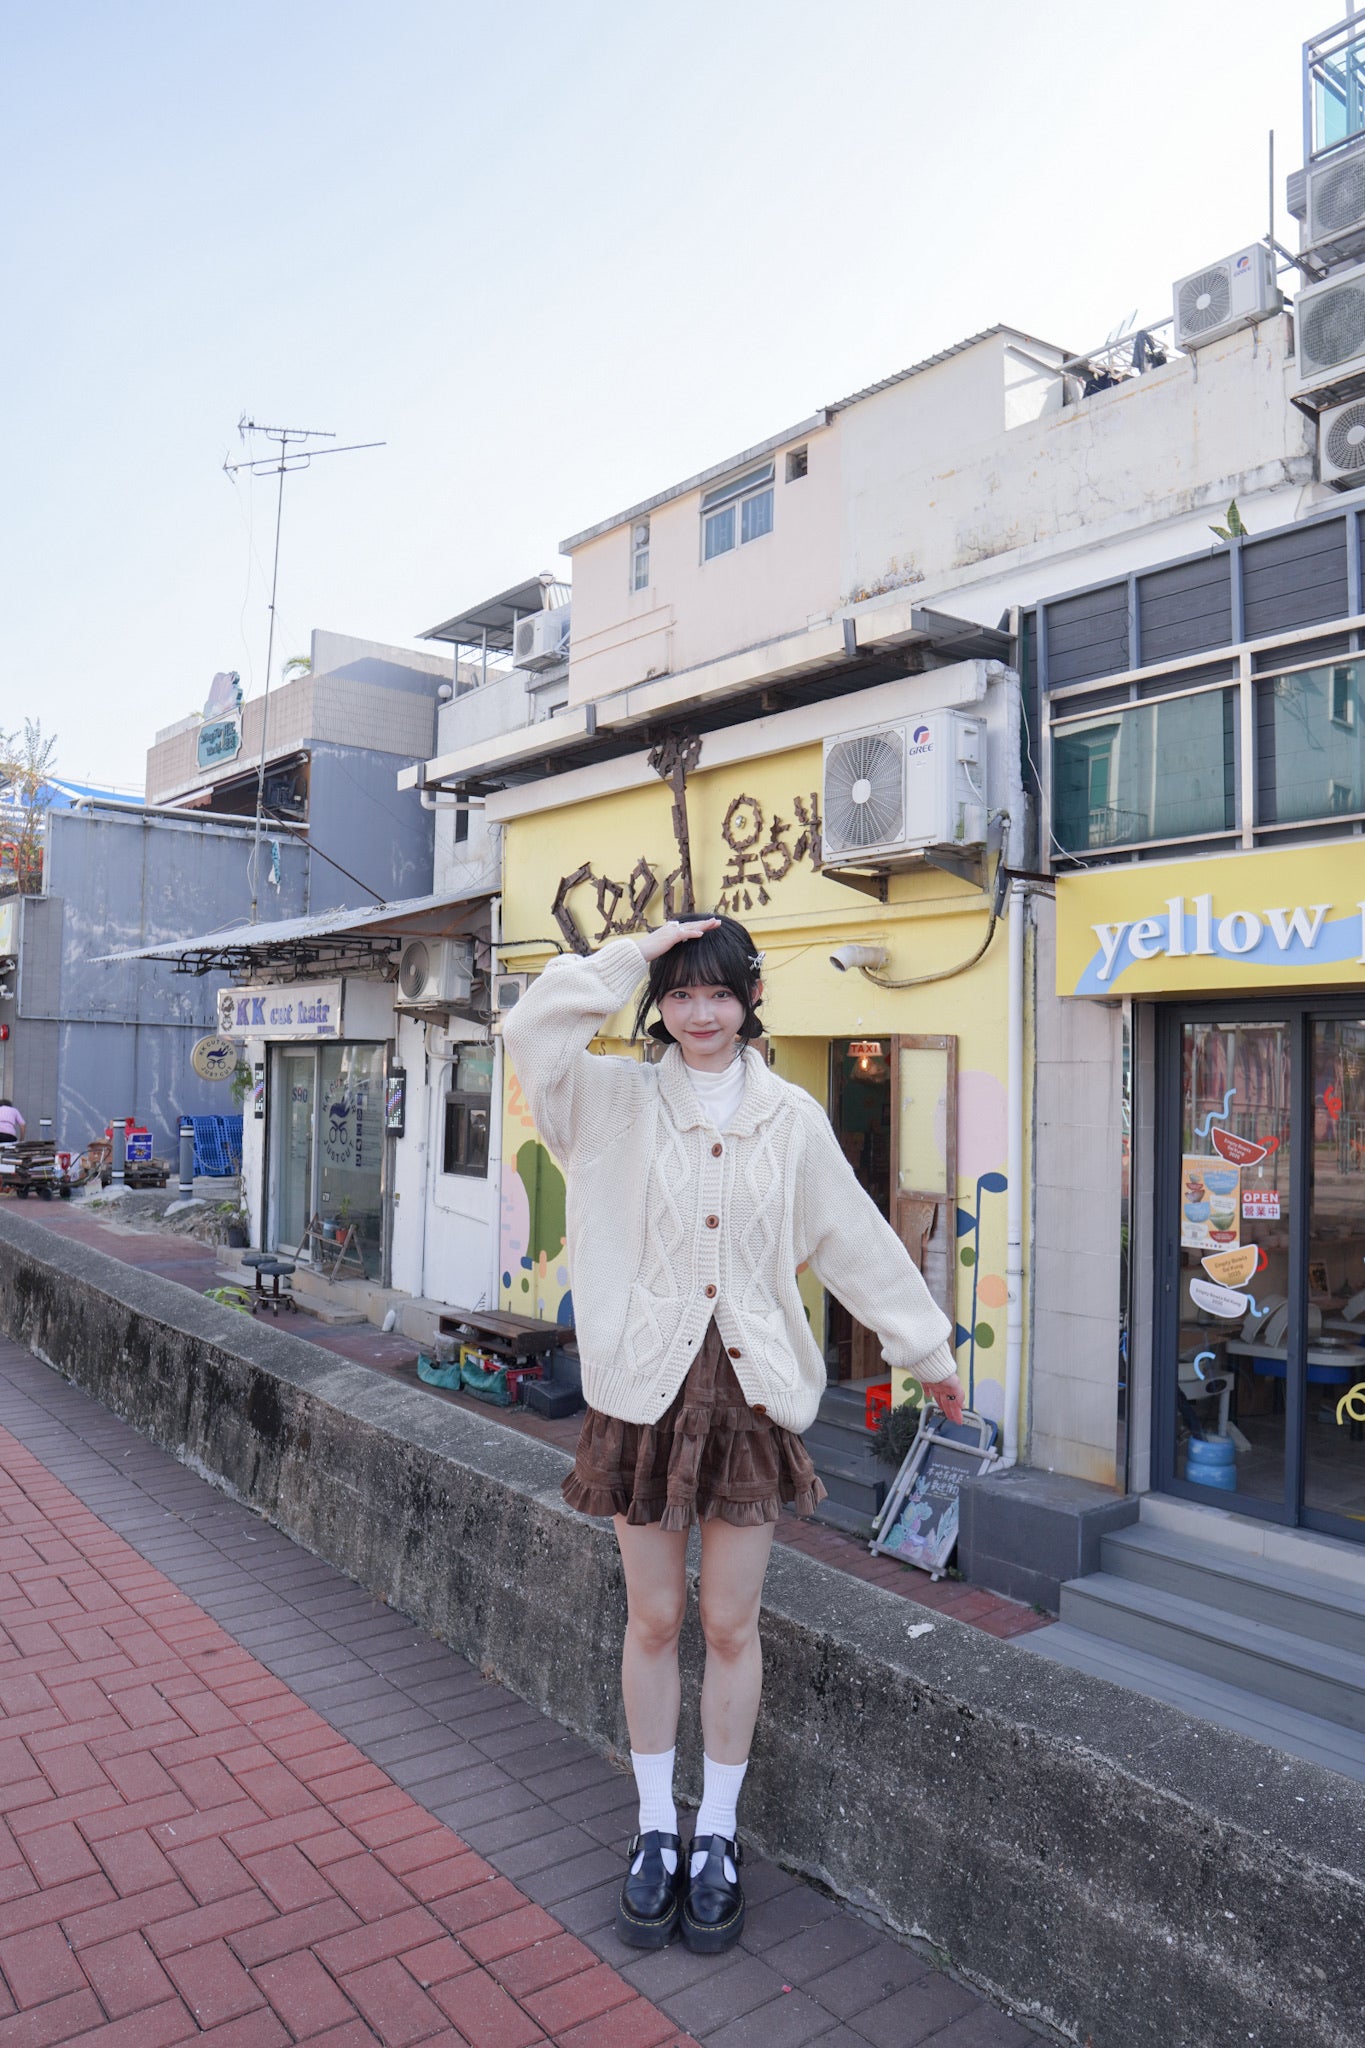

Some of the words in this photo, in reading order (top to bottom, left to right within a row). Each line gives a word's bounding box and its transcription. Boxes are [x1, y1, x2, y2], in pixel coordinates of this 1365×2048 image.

[909, 743, 934, 756] GREE
[1090, 893, 1334, 981] yellow
[236, 997, 266, 1026] KK
[270, 1004, 293, 1025] cut
[297, 997, 330, 1024] hair
[850, 1044, 878, 1053] TAXI
[1243, 1193, 1279, 1203] OPEN
[1244, 1205, 1279, 1217] 營業中
